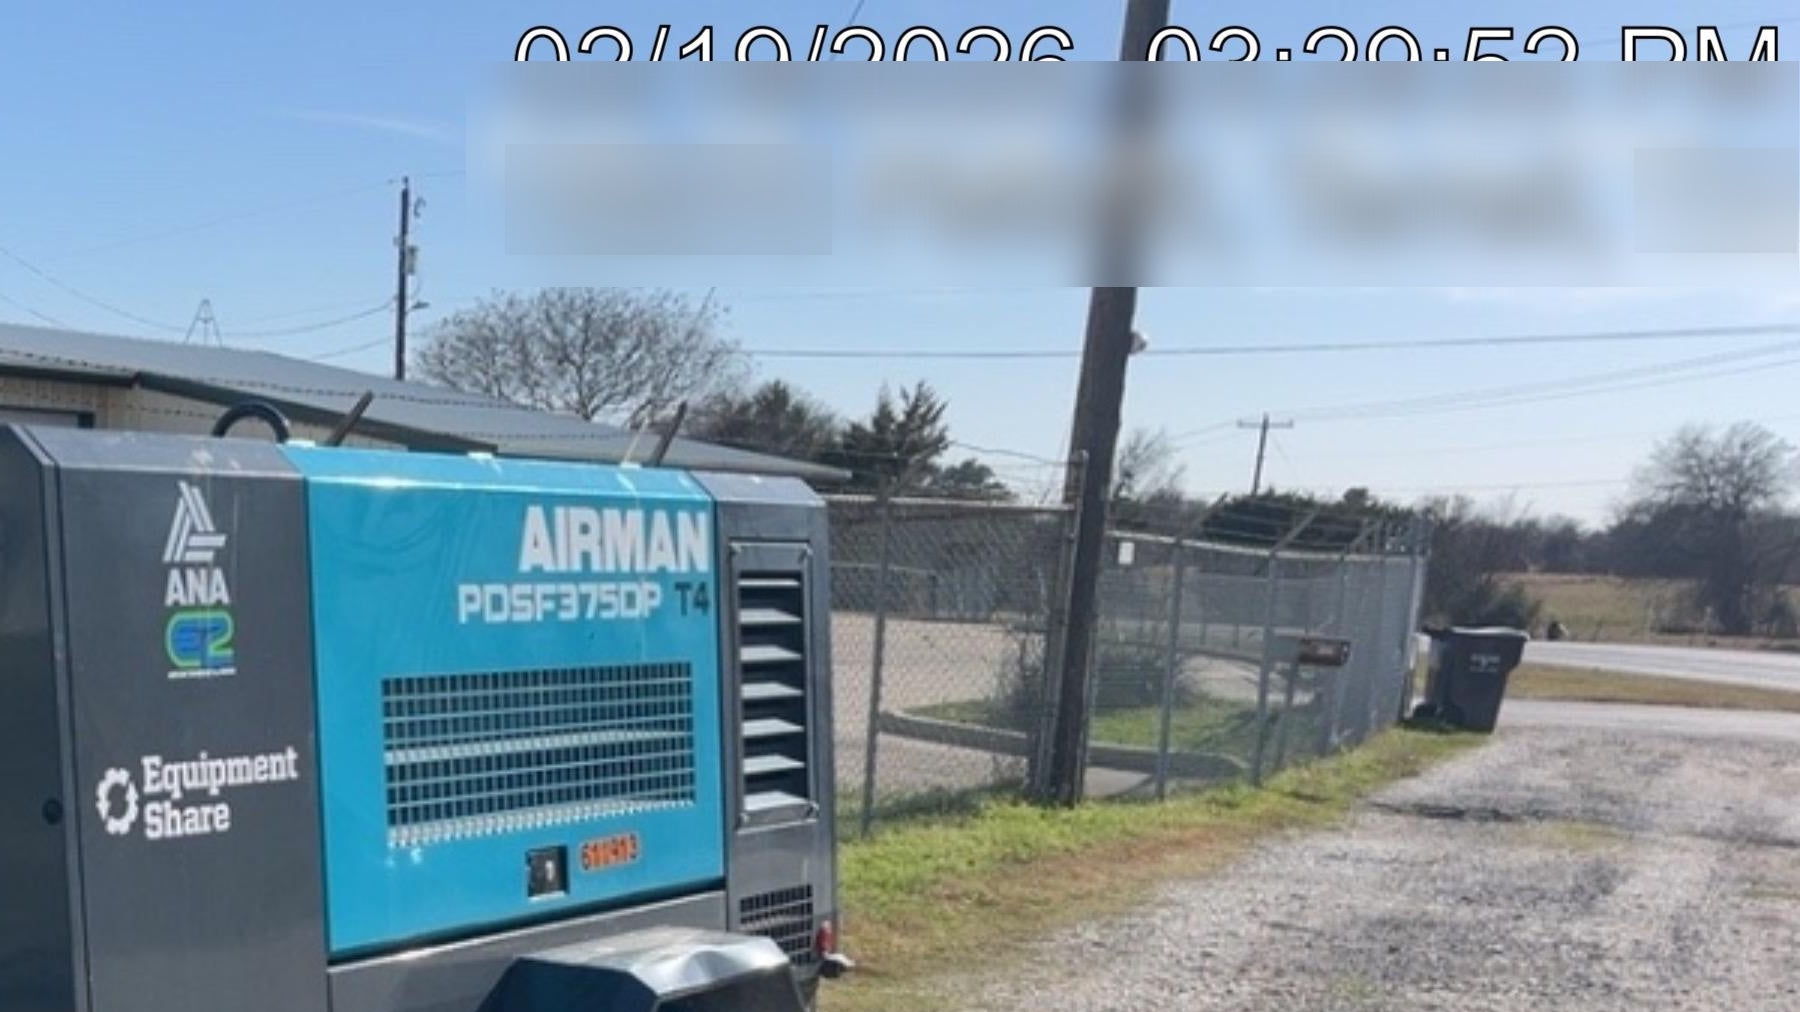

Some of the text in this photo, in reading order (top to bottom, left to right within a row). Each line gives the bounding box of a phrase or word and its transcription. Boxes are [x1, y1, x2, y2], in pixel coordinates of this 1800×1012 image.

[518, 504, 710, 574] AIRMAN
[164, 567, 230, 607] ANA
[458, 581, 710, 624] PDSF375DP T4
[141, 746, 298, 800] Equipment
[144, 800, 231, 840] Share
